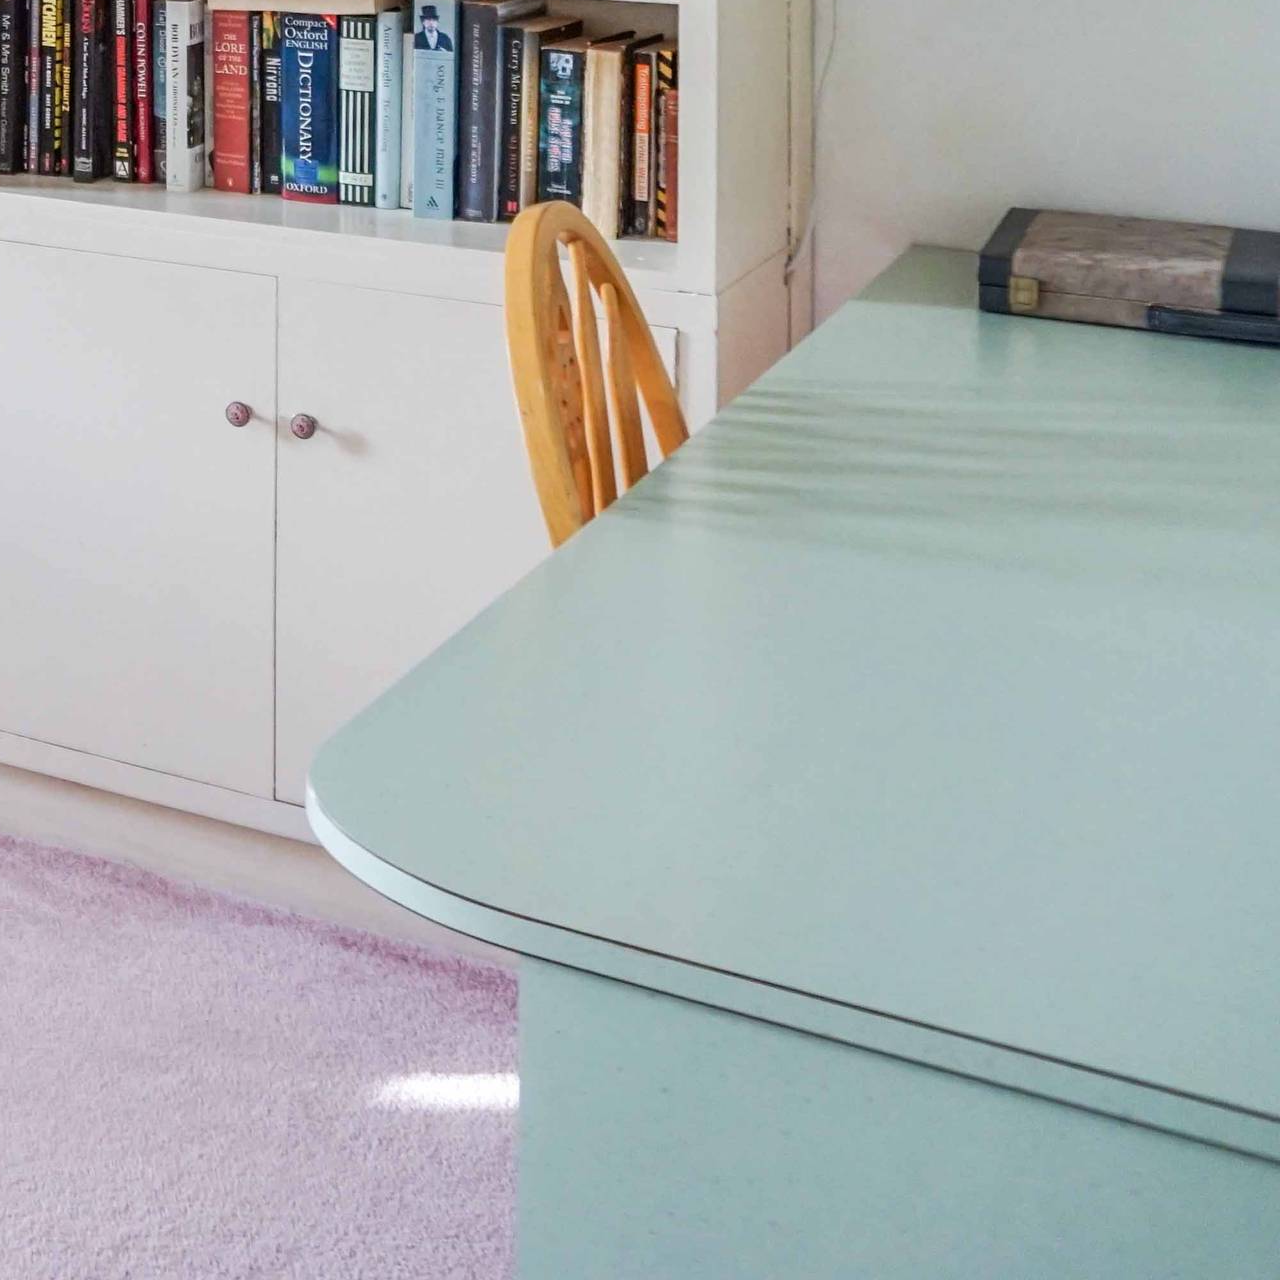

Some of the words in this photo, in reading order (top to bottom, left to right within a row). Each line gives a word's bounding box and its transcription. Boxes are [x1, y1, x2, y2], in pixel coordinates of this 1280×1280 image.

[1, 15, 10, 30] Mr
[284, 17, 327, 29] Compact
[136, 22, 145, 56] COLIN
[284, 28, 328, 41] Oxford
[285, 40, 329, 51] ENGLISH
[383, 25, 393, 49] Anne
[1, 44, 10, 64] Mrs
[215, 43, 246, 55] LORE
[508, 40, 520, 71] Carry
[1, 67, 11, 95] Smith
[137, 59, 146, 99] POWELL
[215, 65, 247, 76] LAND
[266, 58, 281, 101] Nirvana
[511, 74, 520, 91] Me
[298, 50, 313, 164] DICTIONARY
[510, 94, 520, 125] Down
[637, 67, 649, 131] Trainspotting
[285, 182, 328, 195] OXFORD
